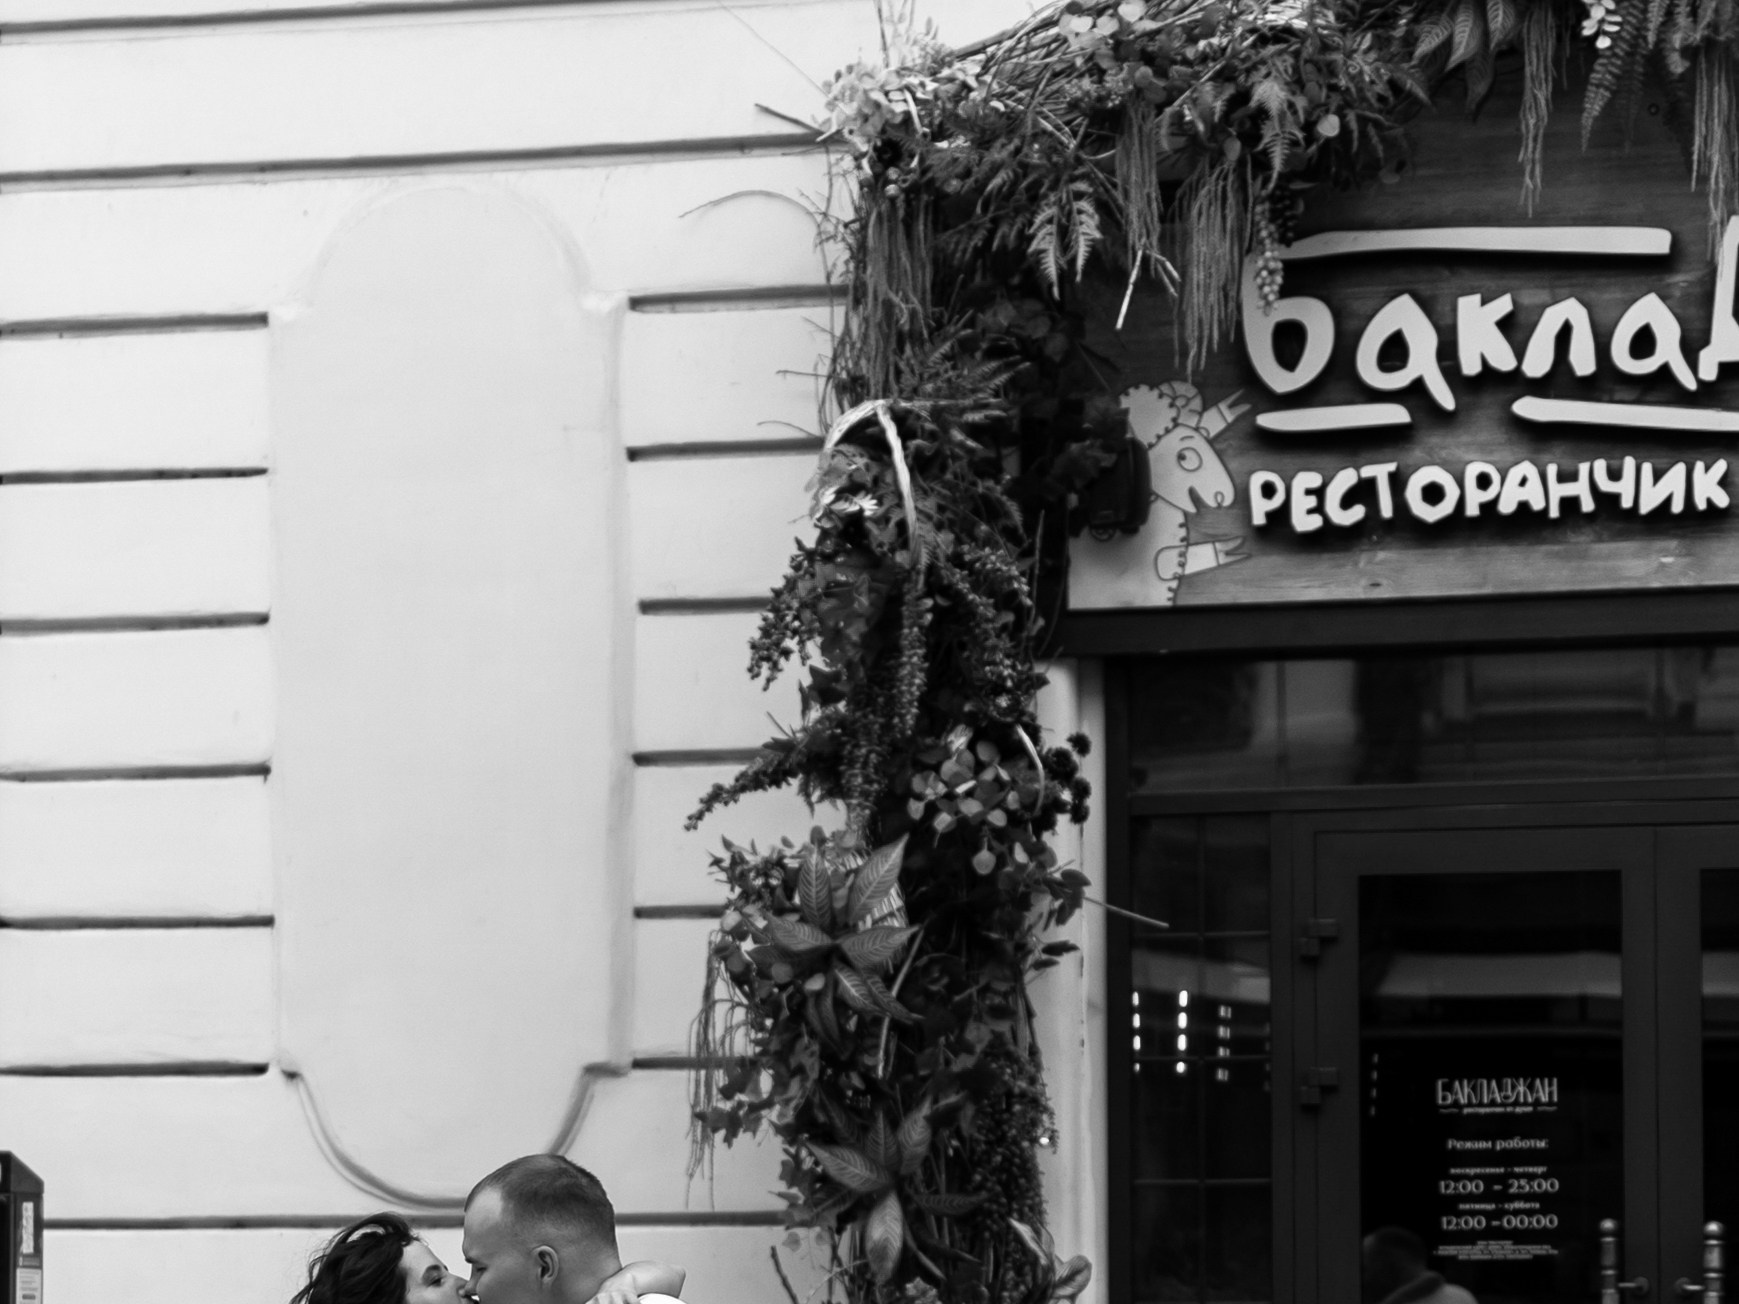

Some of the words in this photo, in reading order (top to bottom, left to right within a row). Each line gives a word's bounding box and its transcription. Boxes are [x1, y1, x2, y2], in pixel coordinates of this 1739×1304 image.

[1249, 455, 1730, 533] РЕСТОРАНЧИК
[1436, 1077, 1559, 1105] БАКЛАДЖАН
[1447, 1138, 1493, 1150] Режим
[1495, 1136, 1549, 1151] работы:
[1439, 1179, 1485, 1195] 12:00
[1441, 1215, 1487, 1231] 12:00
[1502, 1213, 1559, 1230] 00:00
